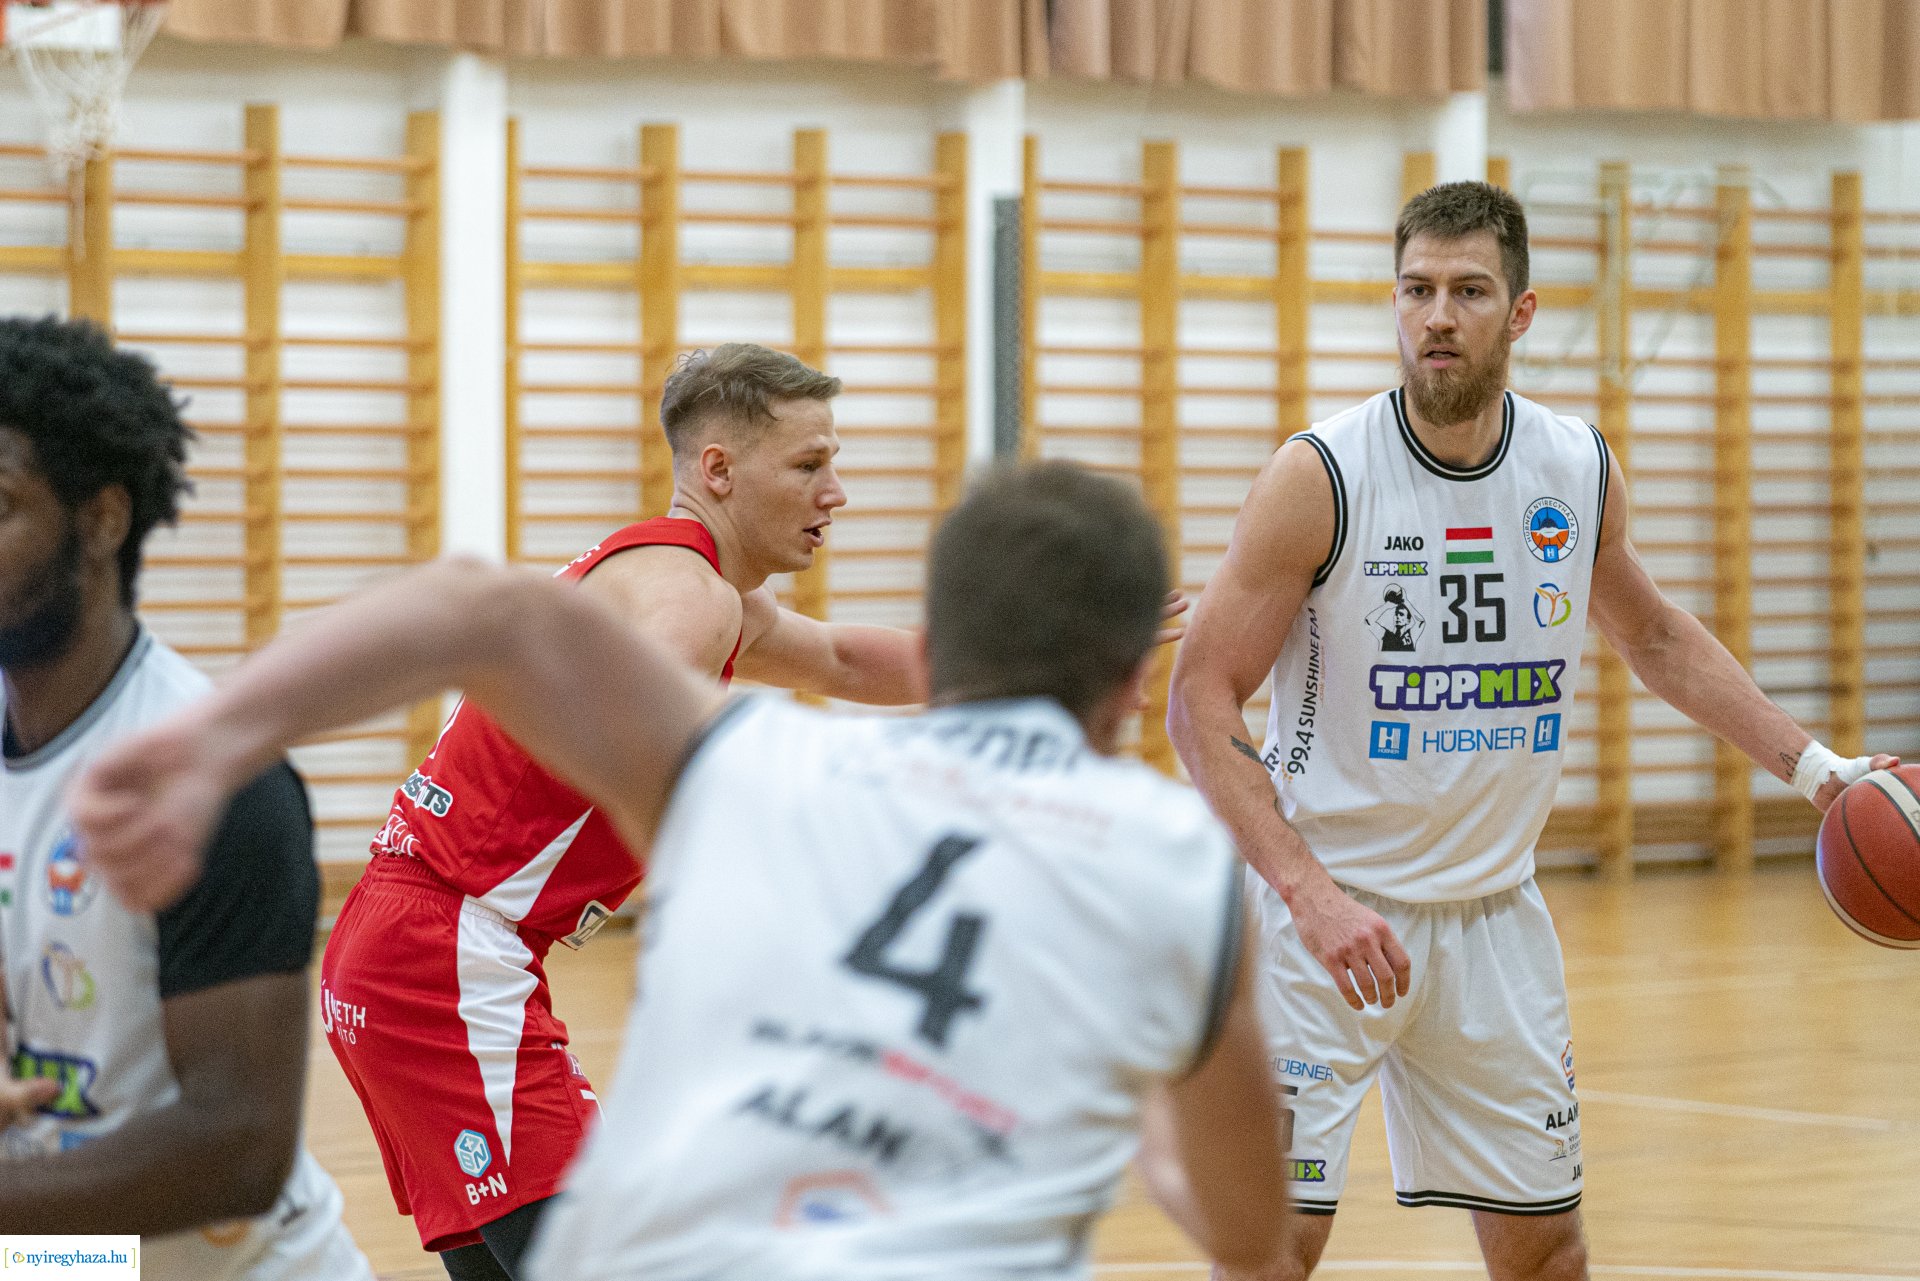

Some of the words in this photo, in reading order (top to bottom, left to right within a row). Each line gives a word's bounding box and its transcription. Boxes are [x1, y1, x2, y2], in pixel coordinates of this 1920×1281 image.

[1384, 536, 1424, 551] JAKO
[1440, 573, 1507, 644] 35
[1287, 730, 1314, 774] 99.4
[1423, 727, 1527, 754] HÜBNER
[841, 834, 985, 1049] 4
[465, 1172, 508, 1206] B+N
